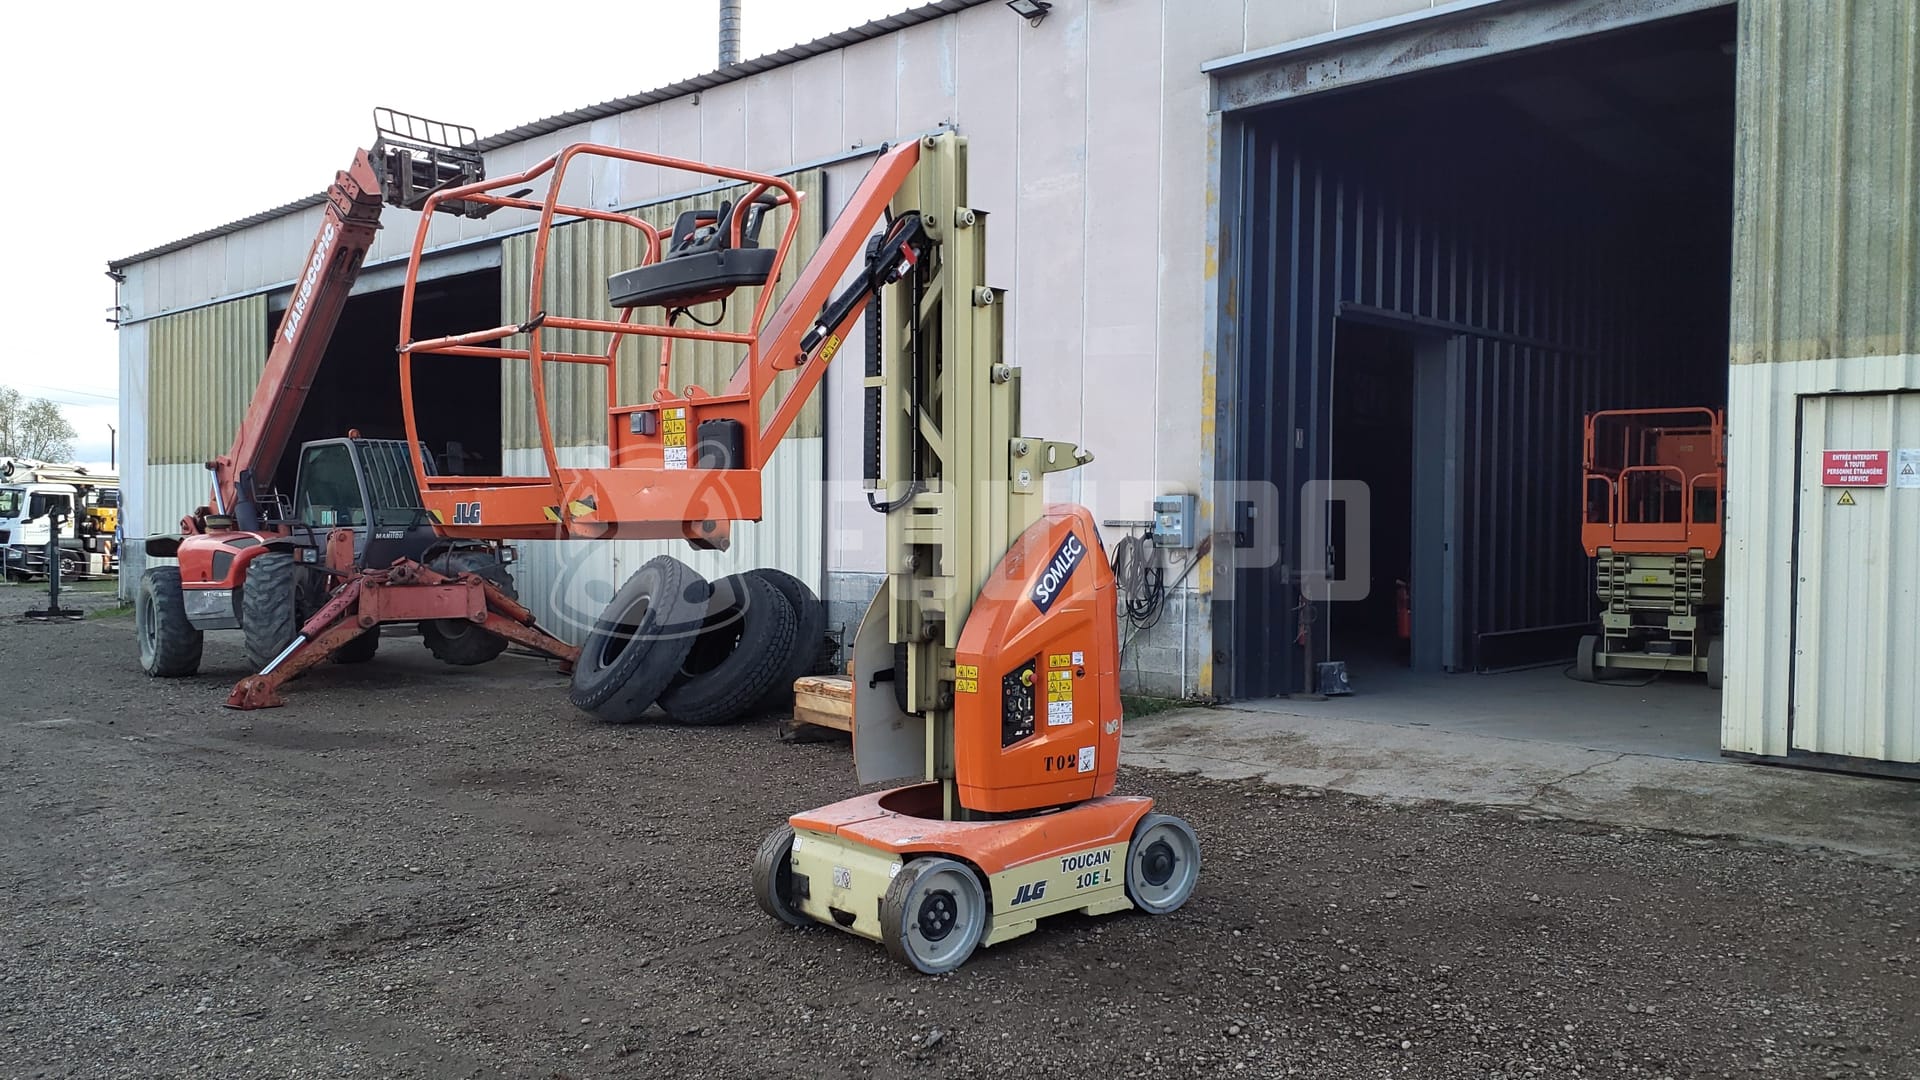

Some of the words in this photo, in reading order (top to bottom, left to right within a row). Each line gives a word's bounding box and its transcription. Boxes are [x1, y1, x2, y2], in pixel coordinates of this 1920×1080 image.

[284, 222, 334, 344] MANISCOPIC
[1832, 453, 1851, 461] ENTRÉE
[1852, 453, 1879, 461] INTERDITE
[453, 501, 481, 525] JLG
[1036, 535, 1082, 604] SOMLEC
[1061, 849, 1111, 873] TOUCAN
[1103, 868, 1112, 883] L
[1010, 880, 1047, 906] JLG
